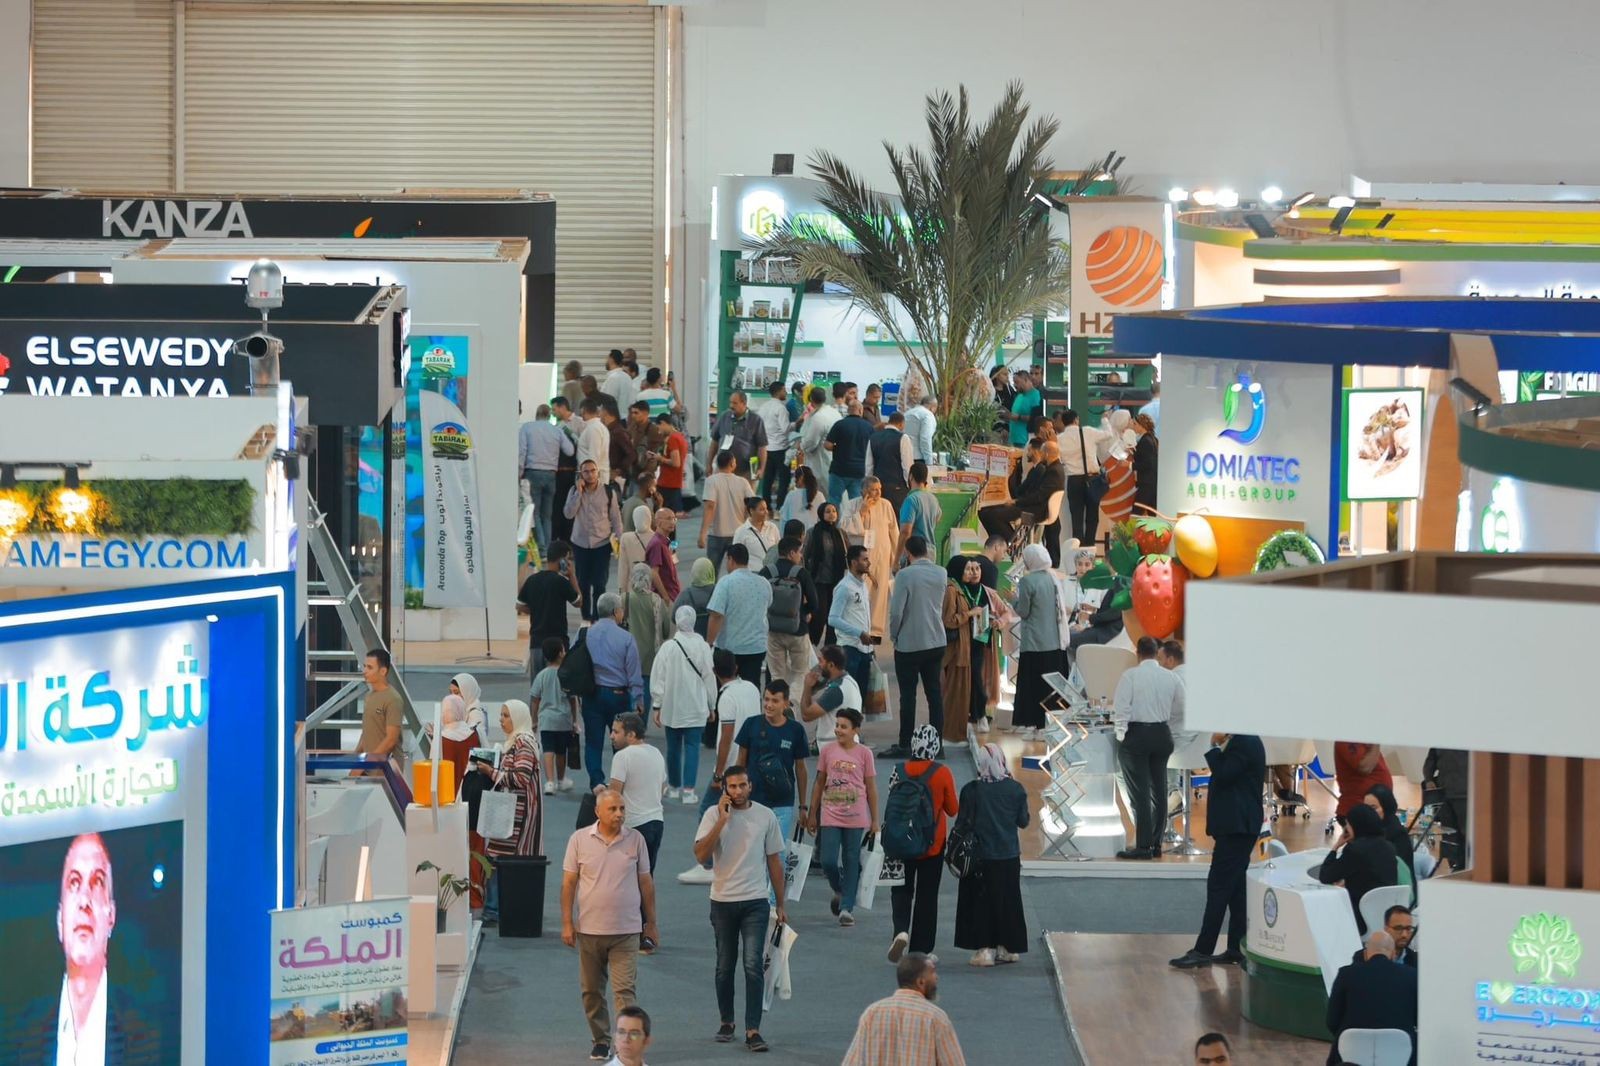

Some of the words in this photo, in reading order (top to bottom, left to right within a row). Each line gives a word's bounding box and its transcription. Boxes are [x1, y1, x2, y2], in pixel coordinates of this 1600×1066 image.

[102, 200, 254, 238] KANZA
[26, 336, 234, 366] ELSEWEDY
[26, 376, 230, 399] WATANYA
[1187, 451, 1300, 484] DOMIATEC
[437, 529, 448, 546] Top
[437, 547, 446, 591] Araconda
[43, 643, 210, 752] شركة
[340, 912, 403, 929] كمبوست
[278, 928, 403, 969] الملكة
